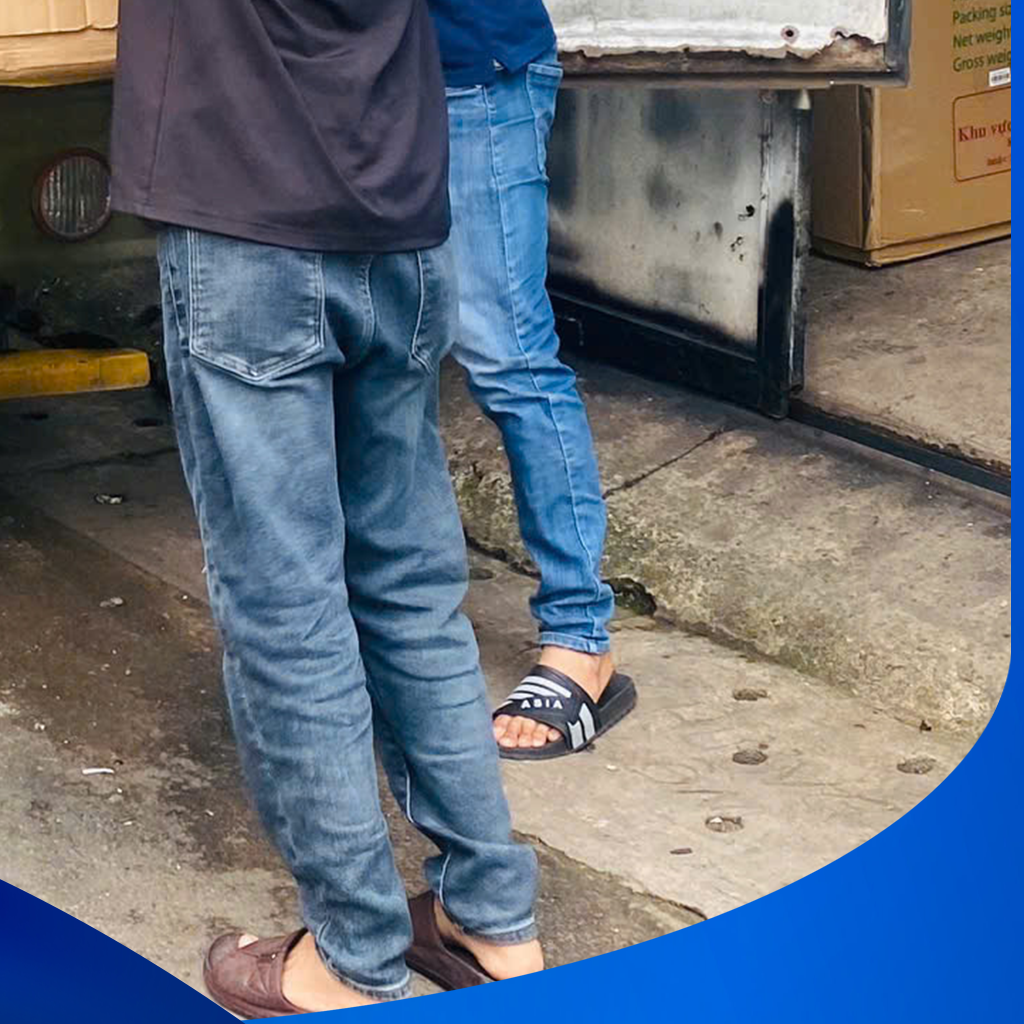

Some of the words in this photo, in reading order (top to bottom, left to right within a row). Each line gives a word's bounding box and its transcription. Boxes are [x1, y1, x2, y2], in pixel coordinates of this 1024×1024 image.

[952, 6, 997, 24] Packing
[953, 33, 973, 48] Net
[952, 55, 985, 73] Gross
[958, 125, 987, 142] Khu
